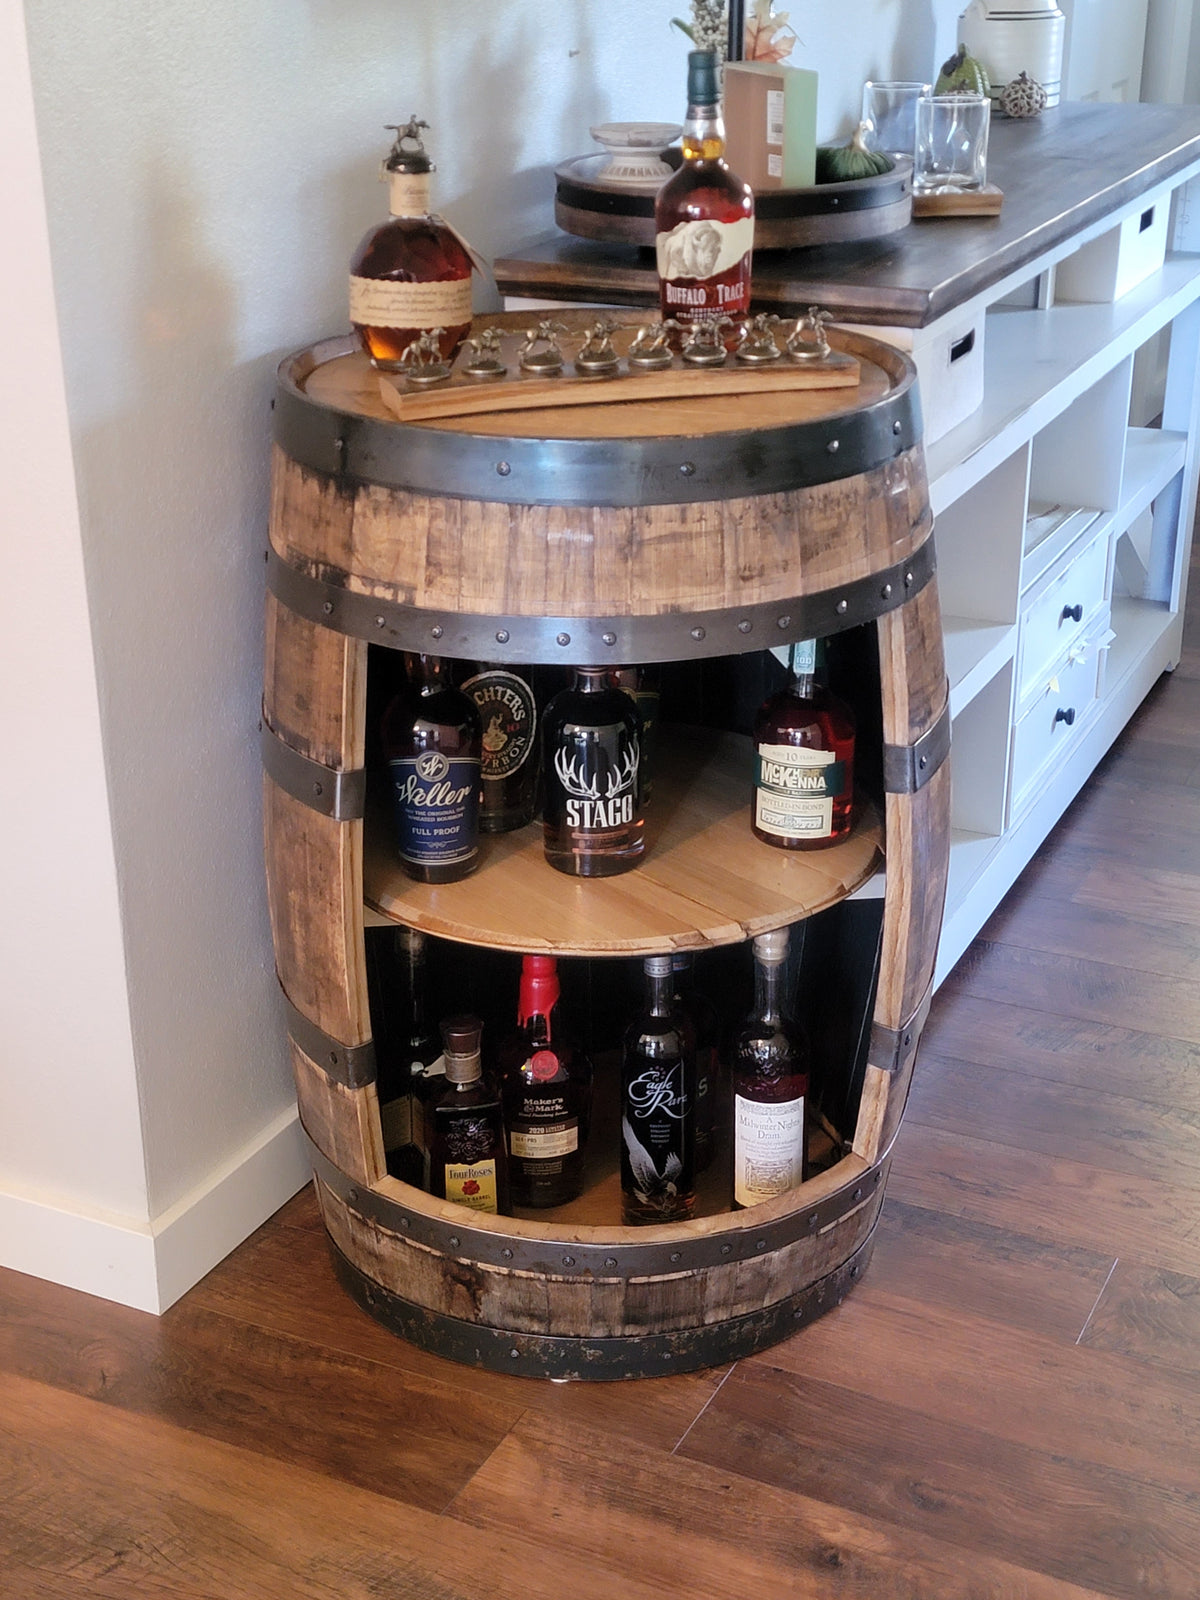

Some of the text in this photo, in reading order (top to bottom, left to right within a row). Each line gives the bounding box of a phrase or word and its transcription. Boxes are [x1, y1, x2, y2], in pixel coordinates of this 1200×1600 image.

[666, 282, 744, 305] BUFFALO TRACE
[473, 686, 526, 721] CHTER'S
[786, 752, 798, 762] 10
[395, 774, 472, 807] Weller
[566, 795, 633, 828] STAGG
[412, 825, 460, 836] FULL PROOF
[628, 1063, 680, 1107] Eagle
[535, 1104, 564, 1112] Mark
[758, 1130, 781, 1140] Dram
